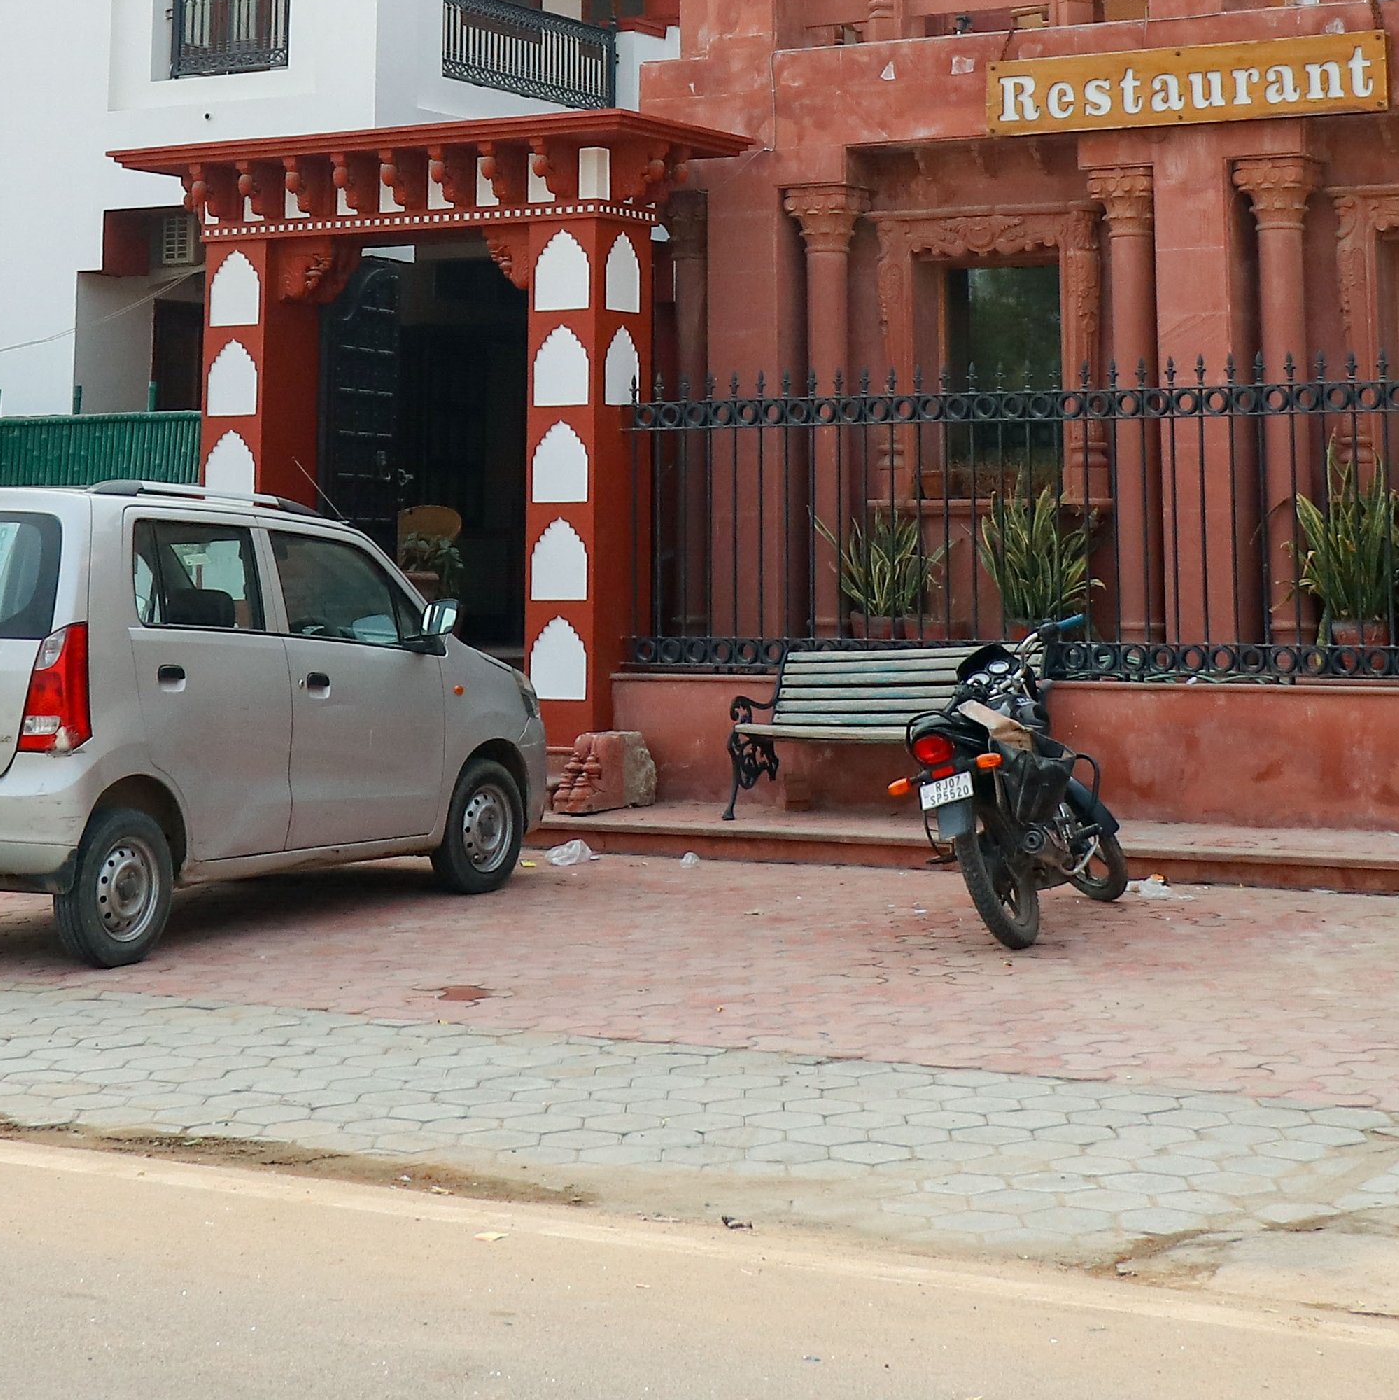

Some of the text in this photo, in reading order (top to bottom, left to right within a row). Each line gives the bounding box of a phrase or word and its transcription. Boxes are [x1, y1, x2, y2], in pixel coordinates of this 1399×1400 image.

[999, 45, 1374, 122] Restaurant
[935, 776, 960, 792] RJ07
[930, 785, 969, 805] SP5520
